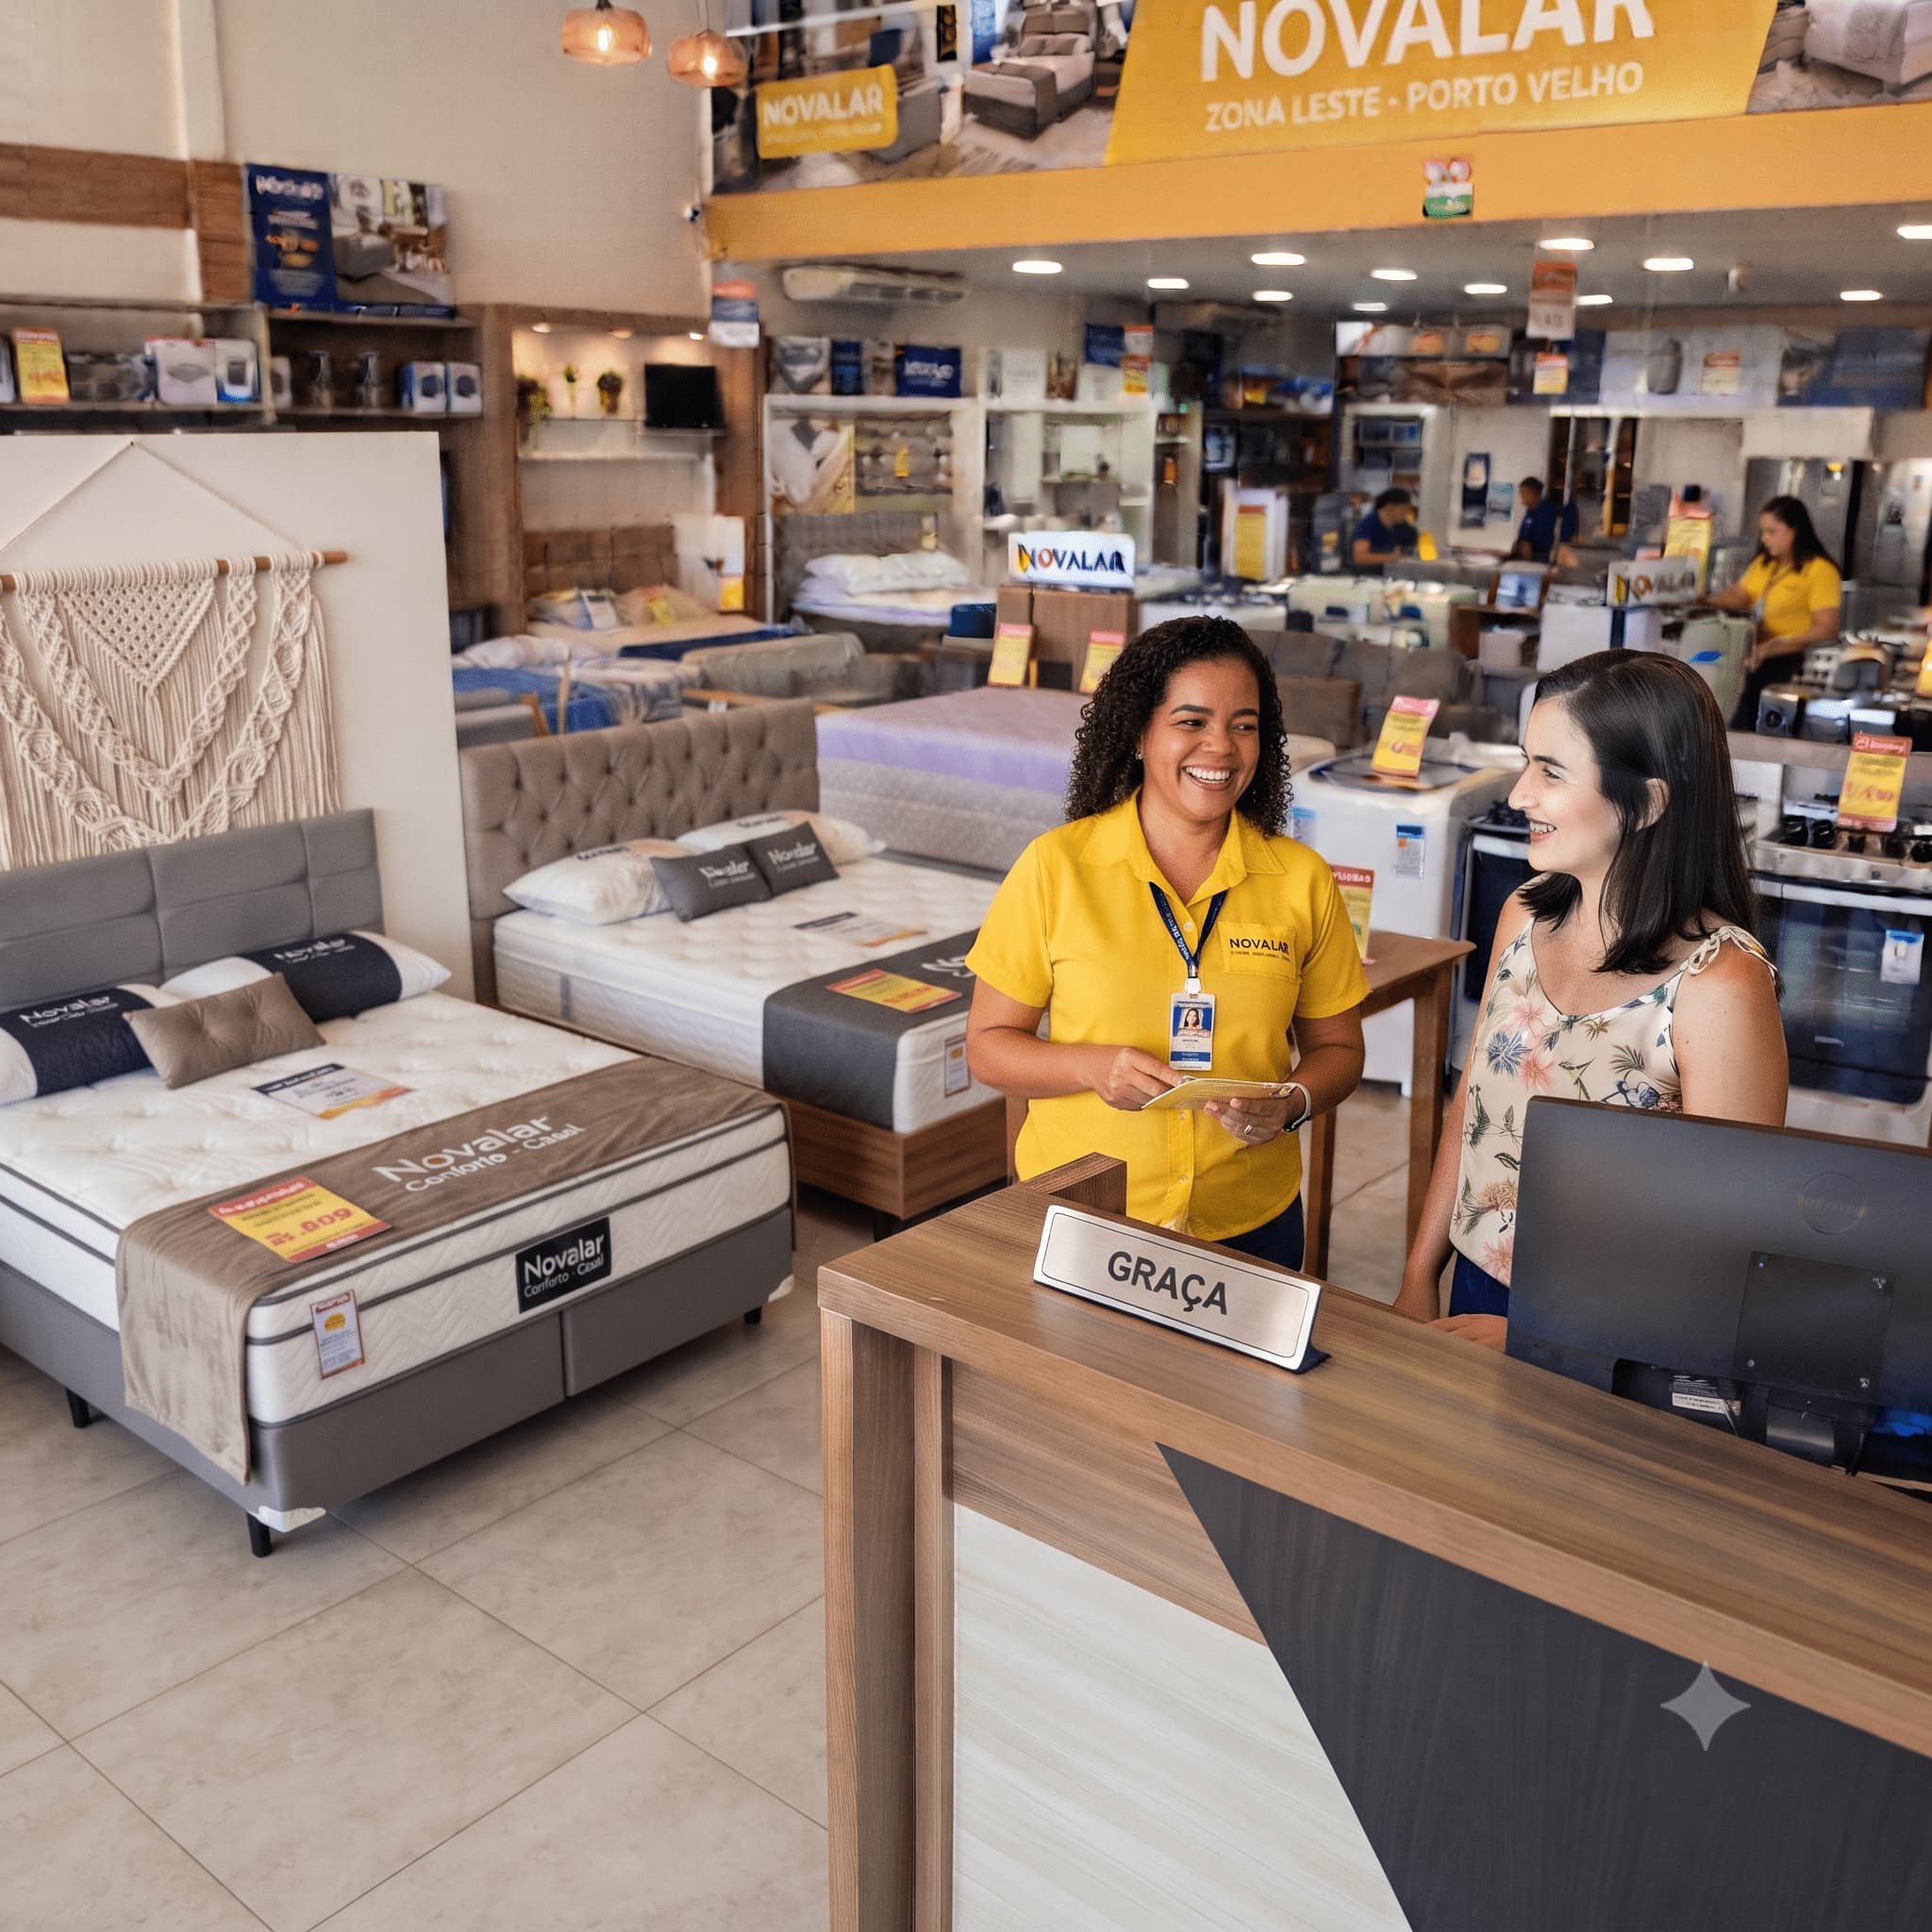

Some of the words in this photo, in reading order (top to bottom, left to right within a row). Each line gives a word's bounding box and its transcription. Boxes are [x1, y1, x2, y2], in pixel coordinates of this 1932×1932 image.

[763, 83, 884, 129] NOVALAR
[1205, 96, 1286, 132] ZONA
[1291, 86, 1381, 125] LESTE
[1407, 73, 1518, 113] PORTO
[1527, 61, 1643, 103] VELHO
[1229, 938, 1290, 956] NOVALAR
[371, 1116, 552, 1182] Novalar
[525, 1234, 605, 1284] Novalar
[1108, 1251, 1228, 1315] GRAÇA
[524, 1272, 570, 1298] Conforto
